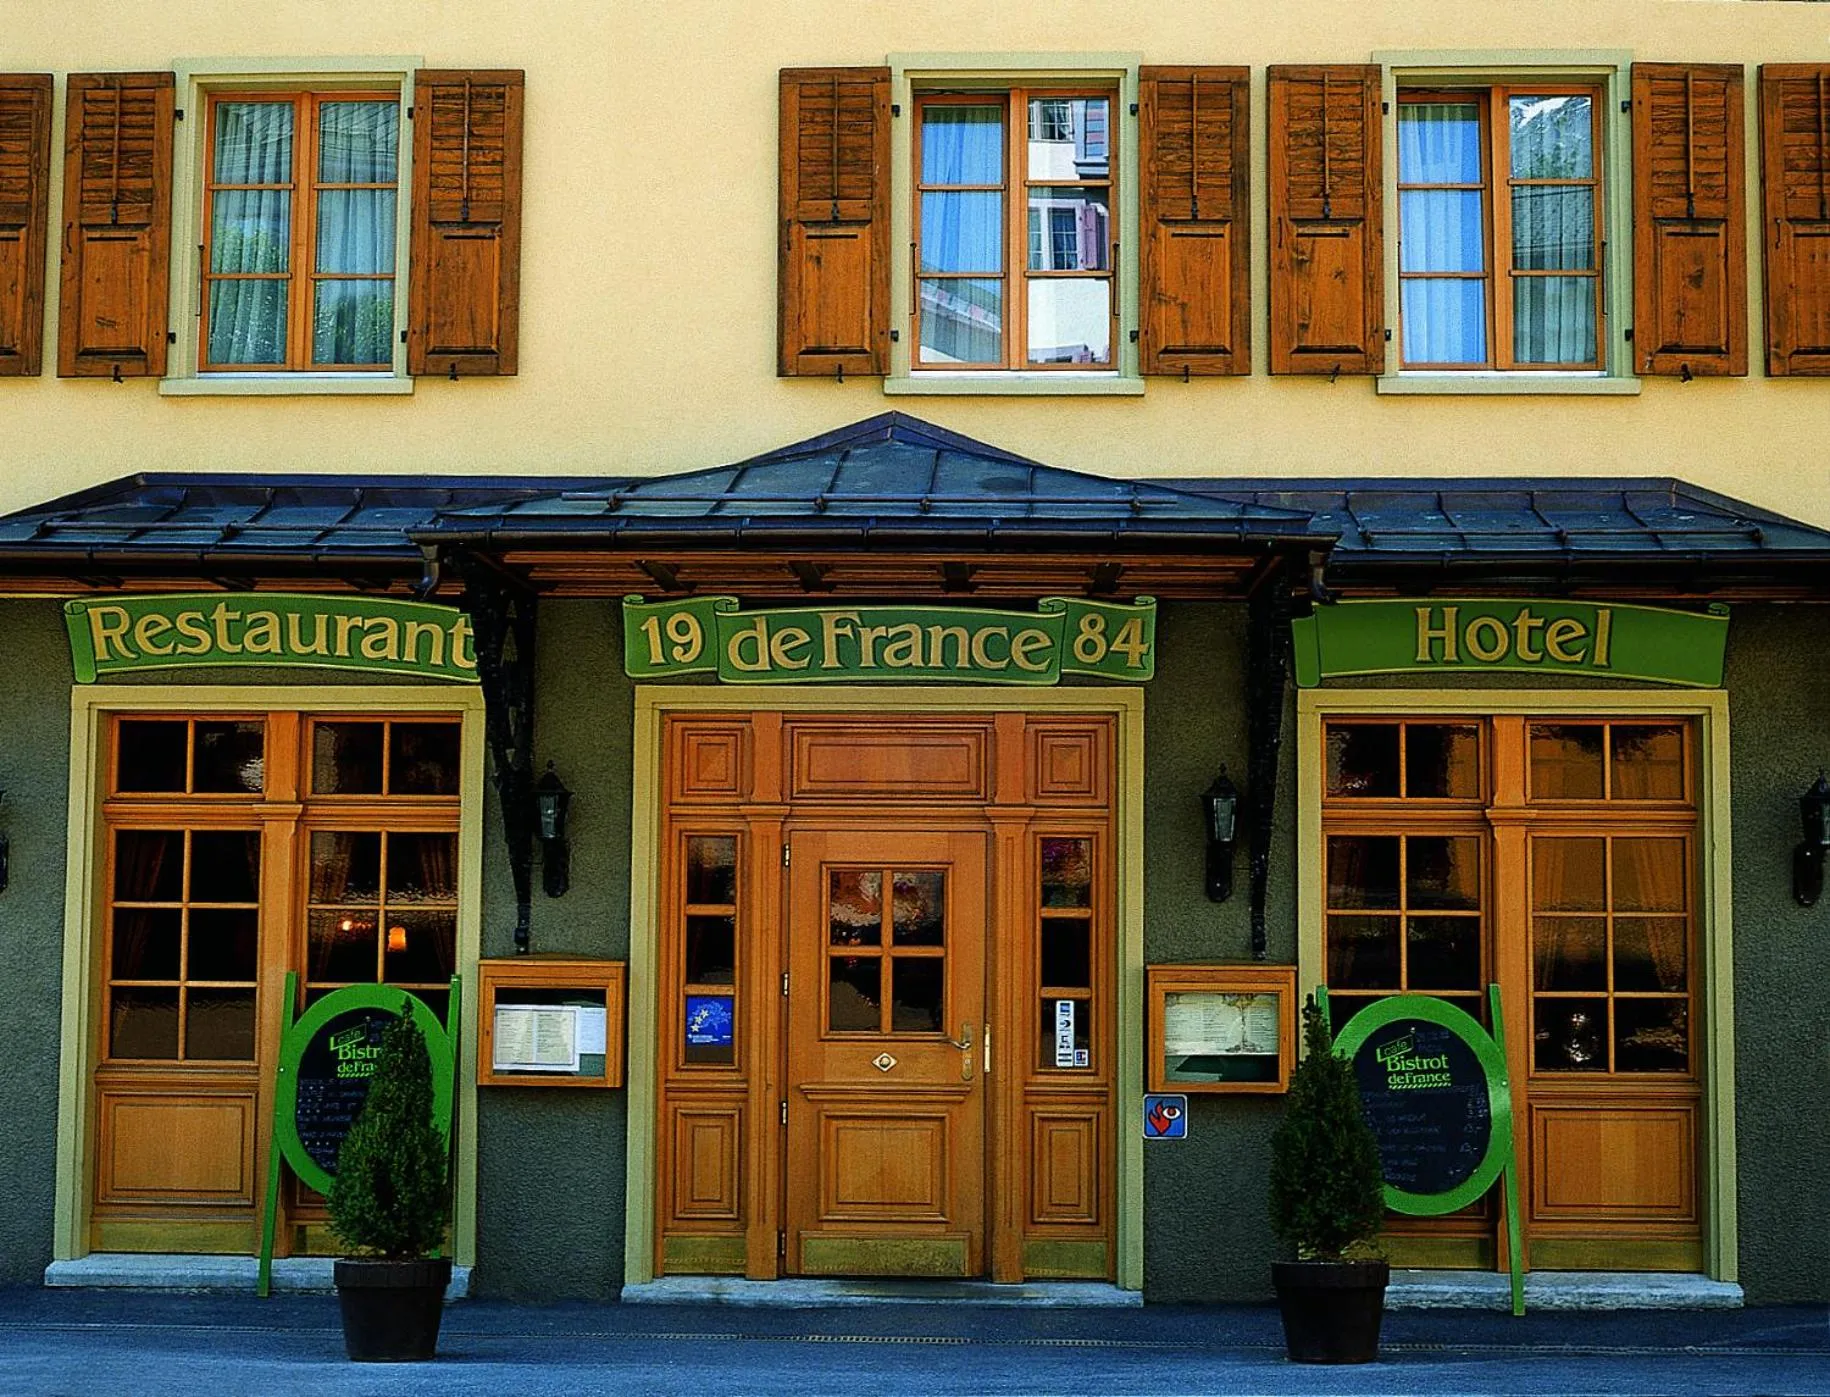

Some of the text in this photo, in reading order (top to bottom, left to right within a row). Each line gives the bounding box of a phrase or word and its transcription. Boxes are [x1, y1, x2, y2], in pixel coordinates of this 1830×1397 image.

[88, 602, 477, 668] Restaurant
[640, 612, 702, 666] 19
[1074, 613, 1151, 667] 84
[1415, 607, 1611, 667] Hotel
[338, 1043, 381, 1060] Bistr
[1386, 1054, 1450, 1072] Bistrot
